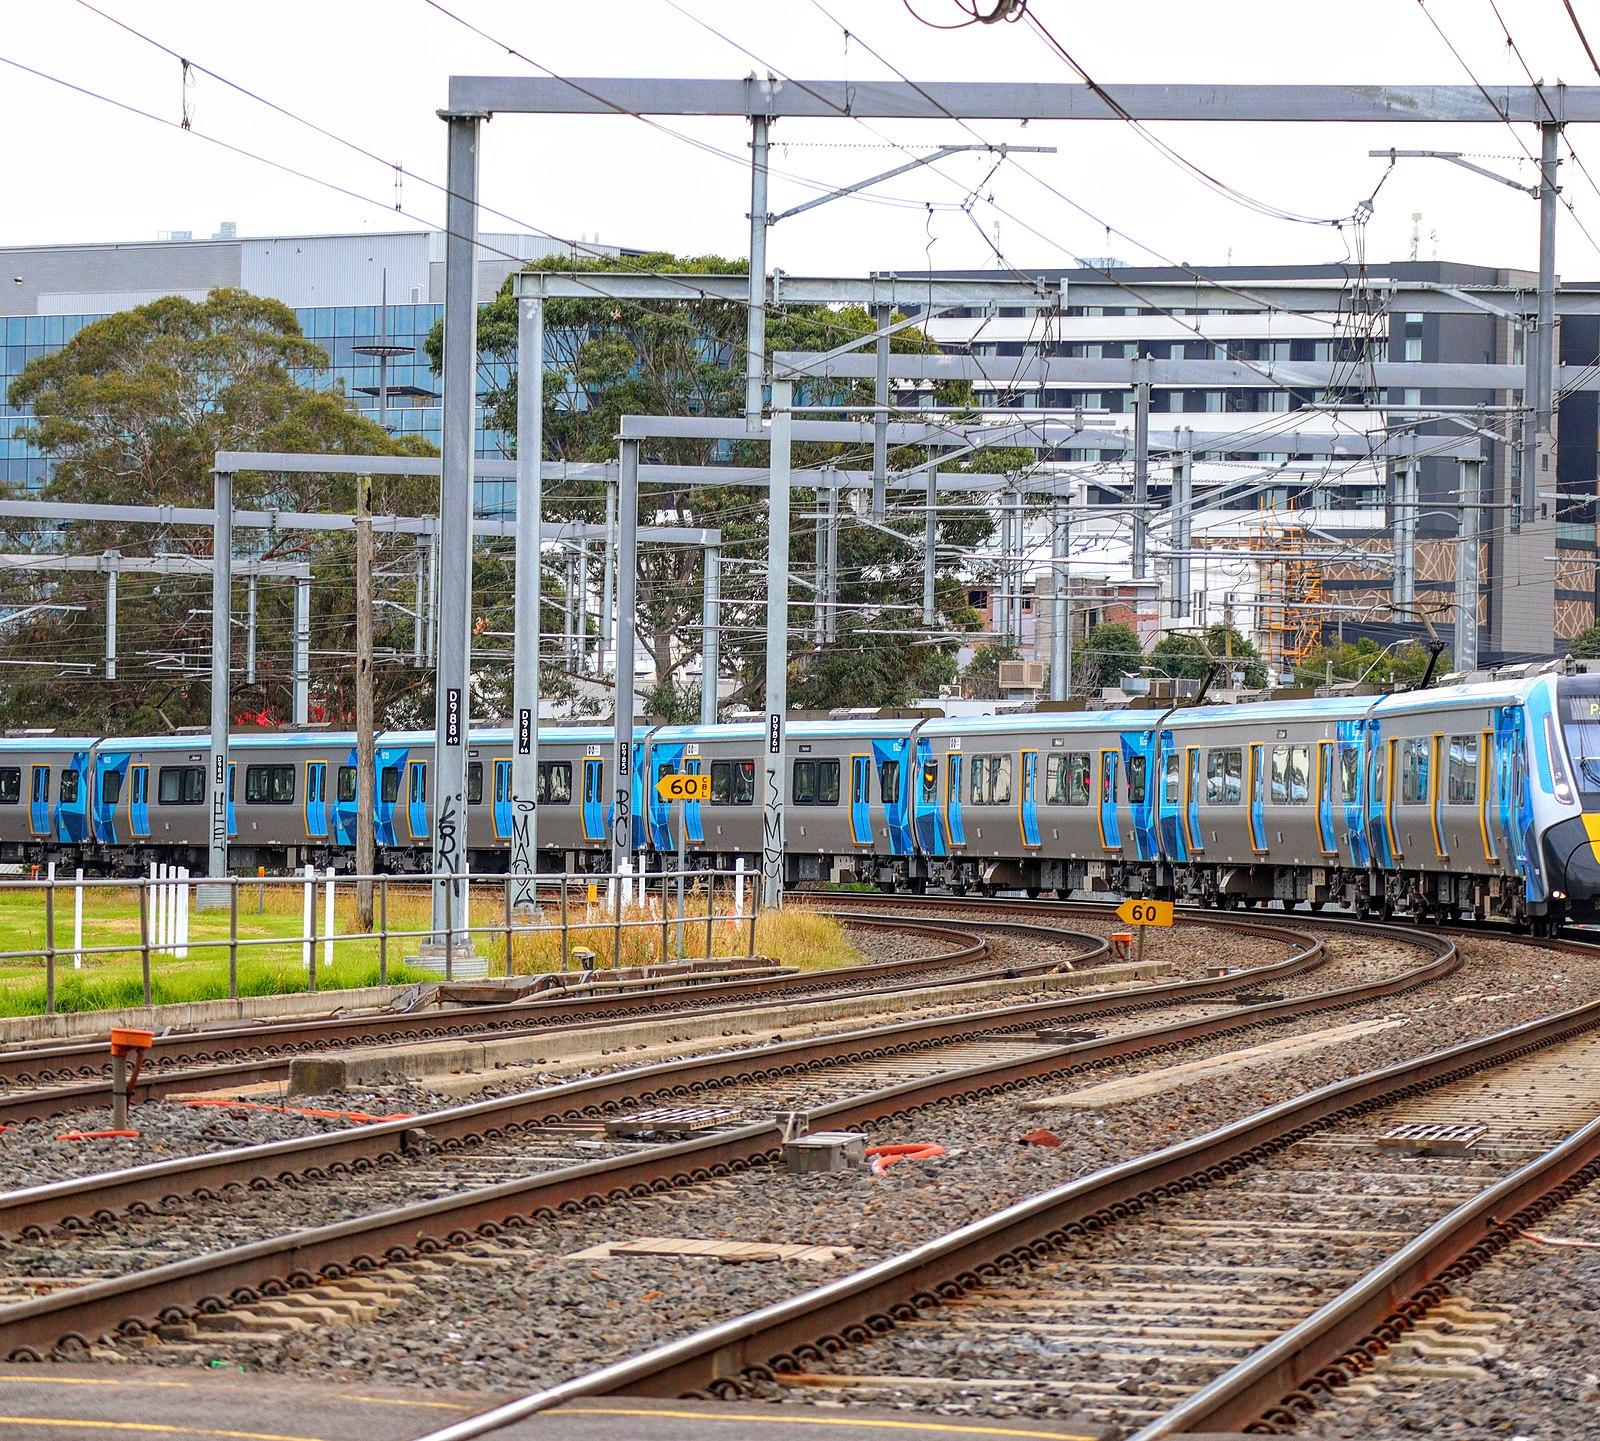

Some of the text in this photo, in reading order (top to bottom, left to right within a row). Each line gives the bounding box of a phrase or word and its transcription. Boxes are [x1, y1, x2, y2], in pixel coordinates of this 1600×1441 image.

[449, 690, 458, 736] D988
[521, 710, 529, 747] D987
[447, 736, 459, 744] 49
[670, 778, 698, 795] 60
[1132, 904, 1157, 922] 60
